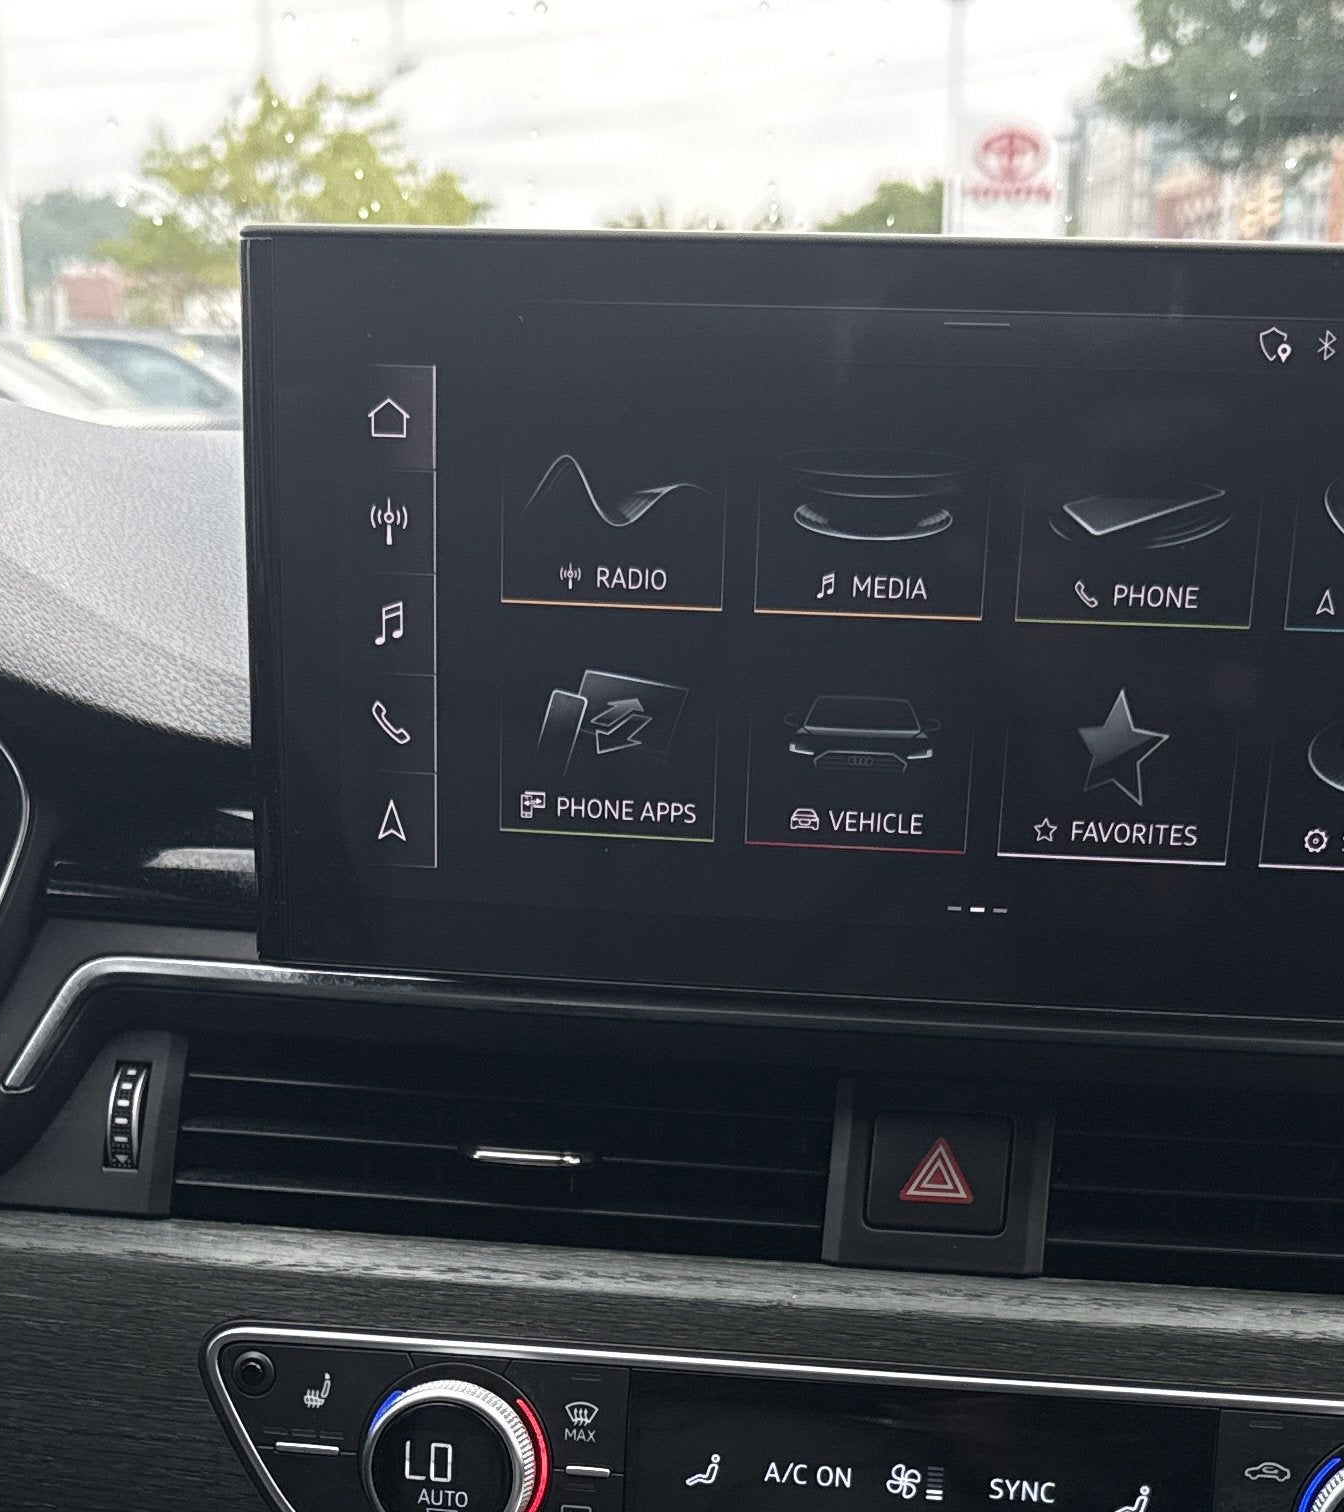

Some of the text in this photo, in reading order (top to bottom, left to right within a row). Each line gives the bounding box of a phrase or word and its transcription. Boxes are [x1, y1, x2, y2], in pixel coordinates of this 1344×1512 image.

[596, 566, 668, 591] RADIO
[852, 574, 928, 601] MEDIA
[1113, 584, 1200, 610] PHONE
[556, 796, 697, 825] PHONE APPS
[828, 809, 924, 836] VEHICLE
[1070, 821, 1198, 847] FAVORITES
[564, 1426, 598, 1444] MAX
[764, 1461, 853, 1489] A/C ON
[417, 1488, 469, 1509] AUTO
[988, 1479, 1056, 1504] SYNC
